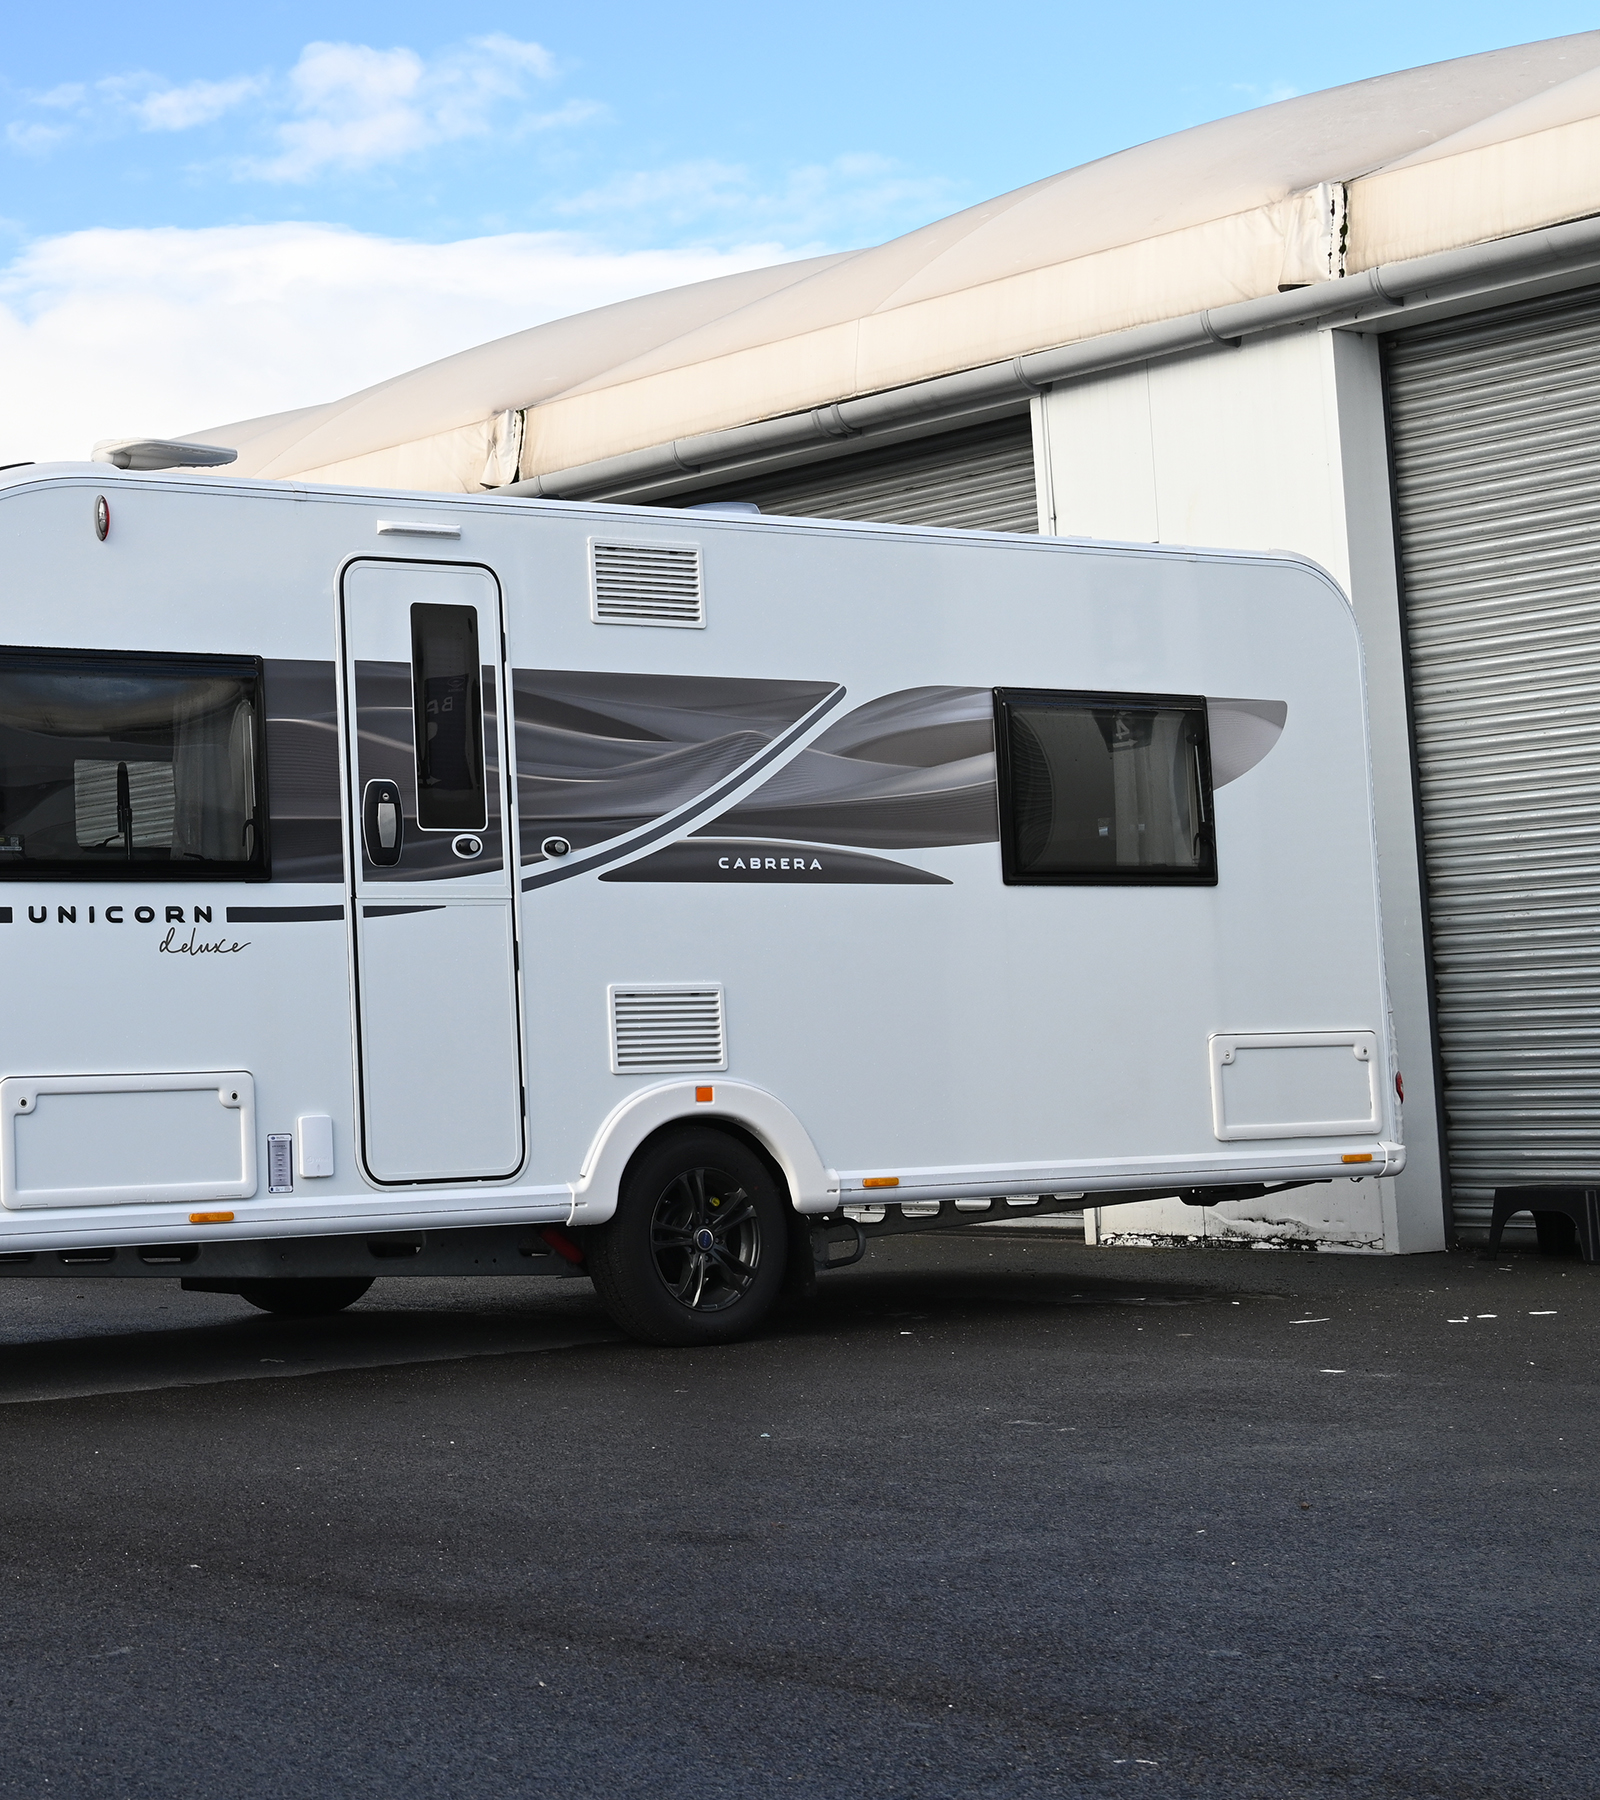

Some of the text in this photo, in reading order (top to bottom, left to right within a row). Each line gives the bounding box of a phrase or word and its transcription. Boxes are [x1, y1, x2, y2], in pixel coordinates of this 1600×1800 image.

[718, 857, 823, 870] CABRERA
[28, 905, 213, 924] UNICORN
[159, 926, 252, 956] deluxe
